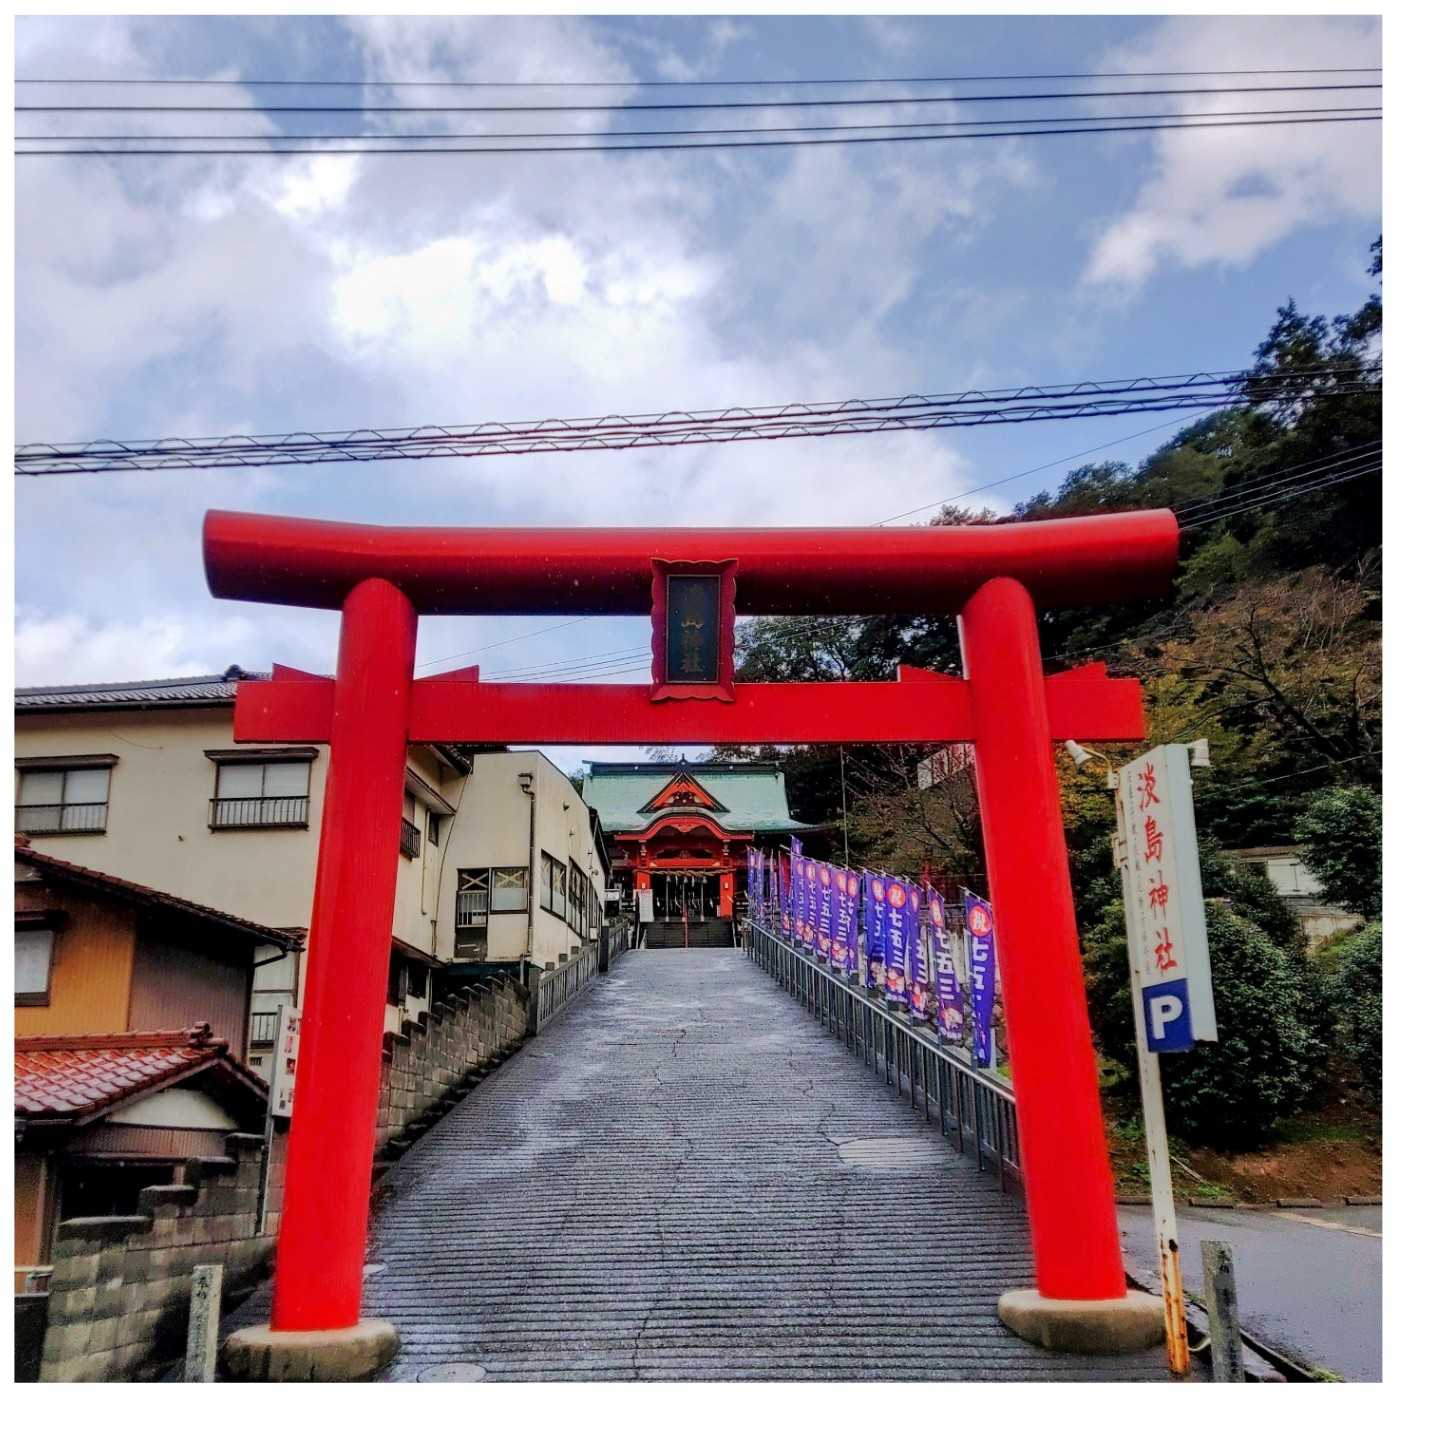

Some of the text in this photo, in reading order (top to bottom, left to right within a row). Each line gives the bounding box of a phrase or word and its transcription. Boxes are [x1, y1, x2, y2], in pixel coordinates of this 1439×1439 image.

[1137, 762, 1178, 977] 淡島神社
[1149, 994, 1184, 1040] P
